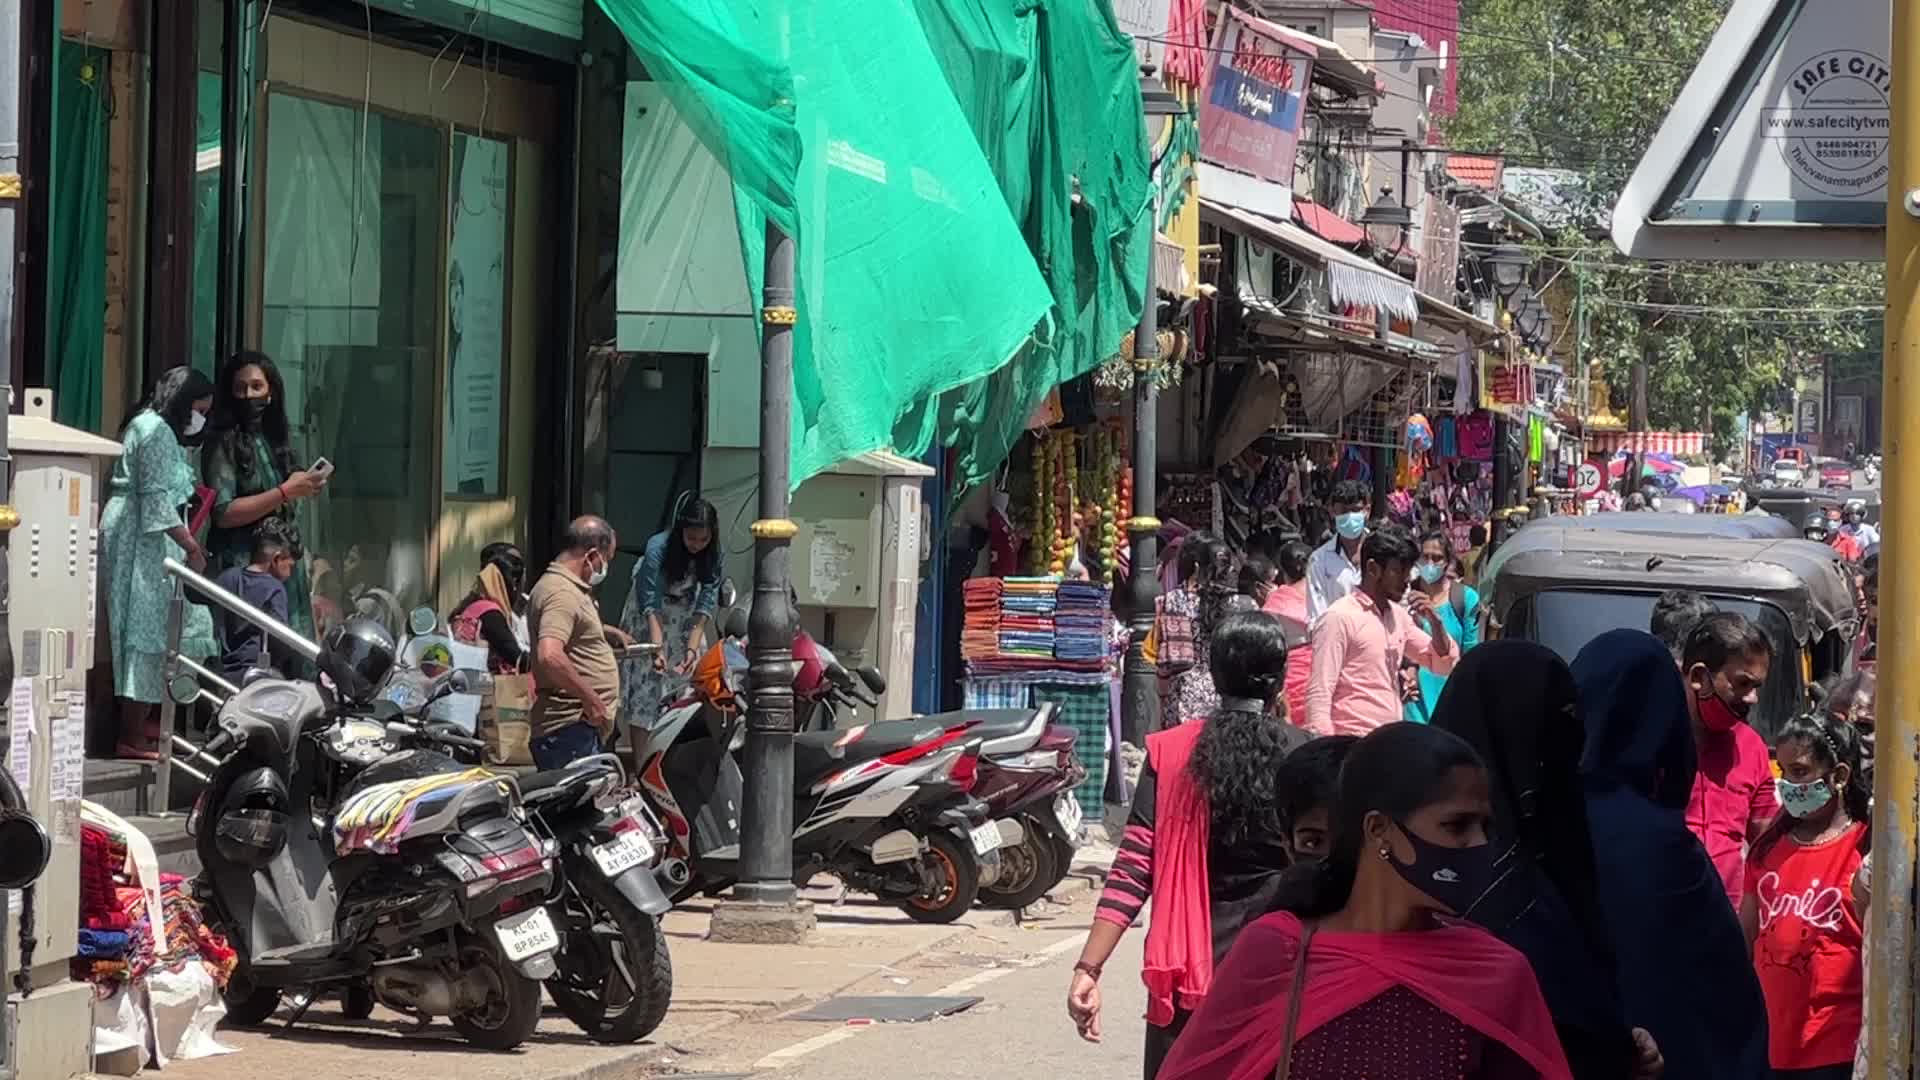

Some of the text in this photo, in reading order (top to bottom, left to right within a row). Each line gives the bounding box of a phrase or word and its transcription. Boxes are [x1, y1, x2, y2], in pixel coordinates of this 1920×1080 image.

[1793, 56, 1891, 95] SAFE CIT
[1757, 871, 1844, 933] Smile
